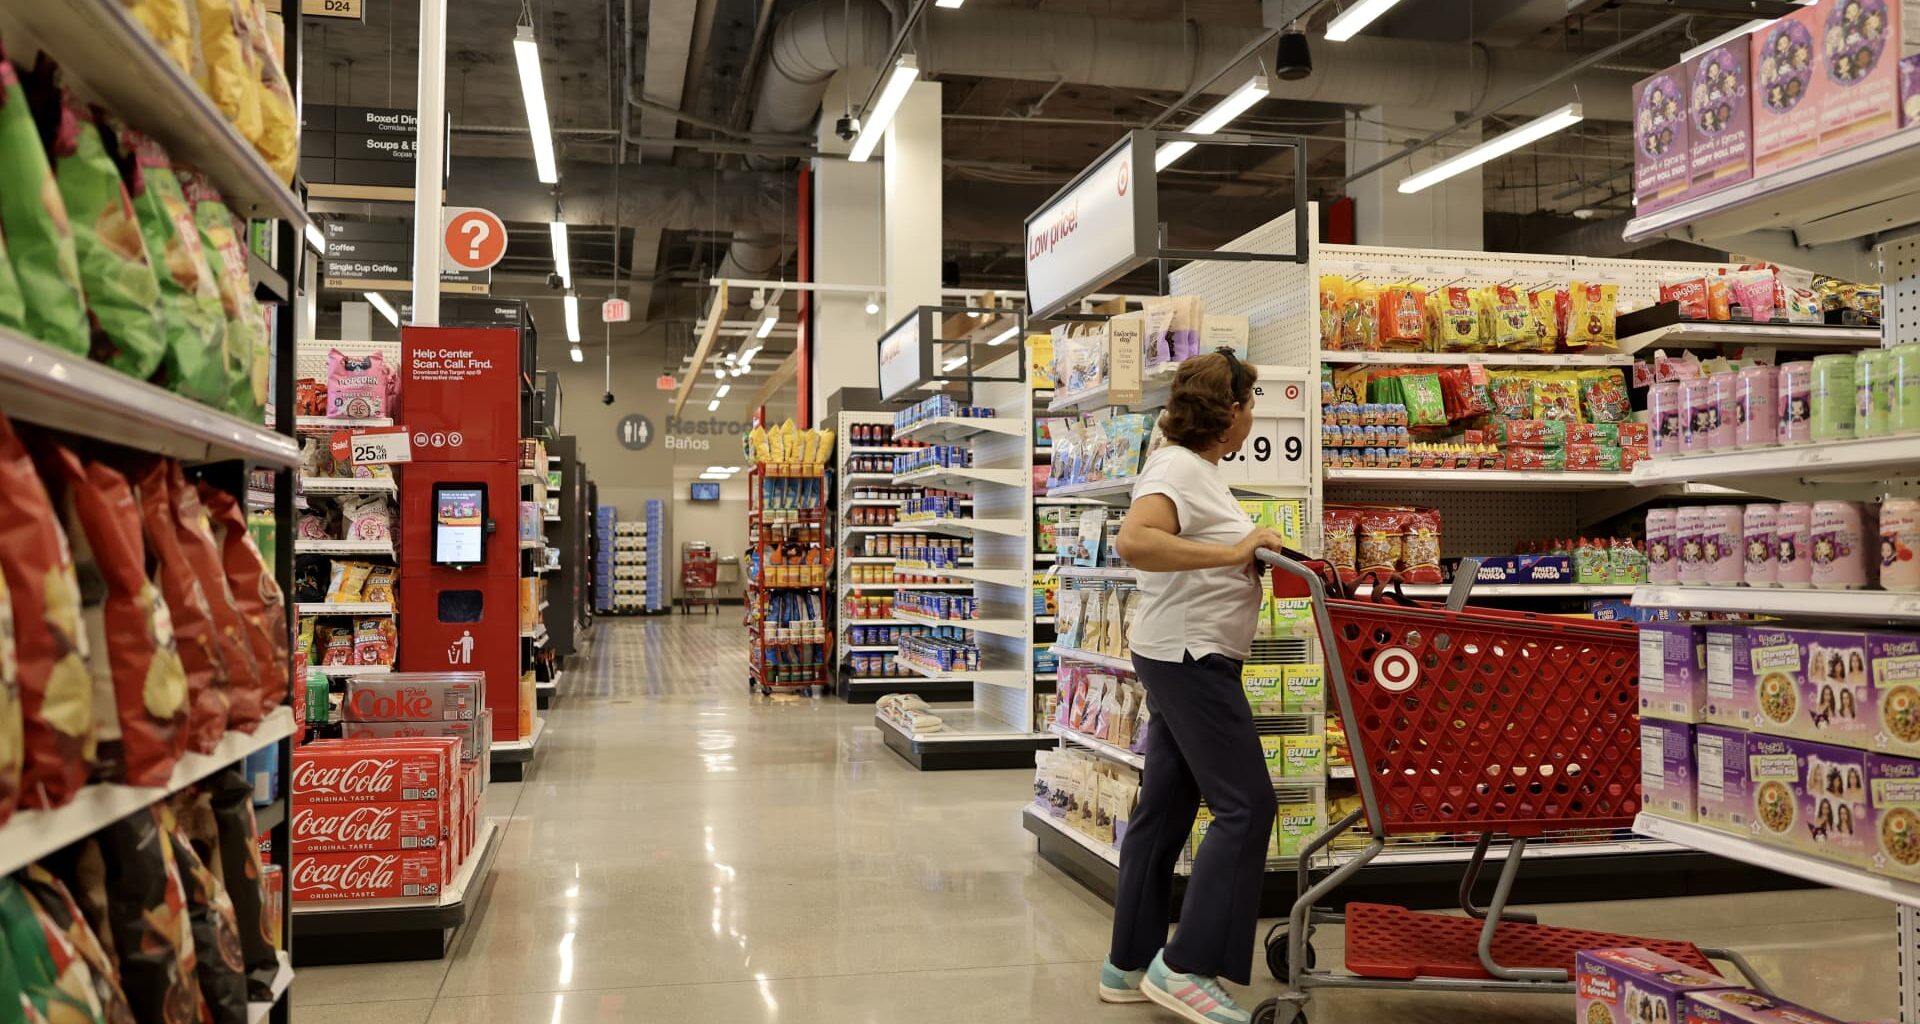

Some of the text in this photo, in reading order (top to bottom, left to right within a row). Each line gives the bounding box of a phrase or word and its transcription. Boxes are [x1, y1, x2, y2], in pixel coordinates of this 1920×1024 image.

[325, 0, 351, 12] D24
[366, 113, 398, 124] Boxed
[379, 124, 406, 132] Comidas
[366, 139, 399, 150] Soups
[401, 141, 409, 150] &
[329, 224, 343, 233] Tea
[1029, 200, 1078, 261] Low price!
[329, 244, 355, 252] Coffee
[329, 263, 398, 274] Single Cup Coffee
[412, 349, 473, 360] Help Center
[412, 359, 493, 369] Scan. Call. Find.
[332, 440, 348, 451] Sale!
[664, 436, 710, 450] Baños
[354, 446, 377, 461] 25
[375, 445, 387, 453] %
[1477, 572, 1507, 580] PAYASO
[1531, 572, 1560, 580] PAYASO
[1277, 599, 1311, 610] BUILT
[1246, 677, 1279, 687] BUILT
[1287, 677, 1321, 687] BUILT
[351, 688, 433, 719] Coke
[1286, 748, 1321, 758] BUILT
[1282, 816, 1316, 826] BUILT
